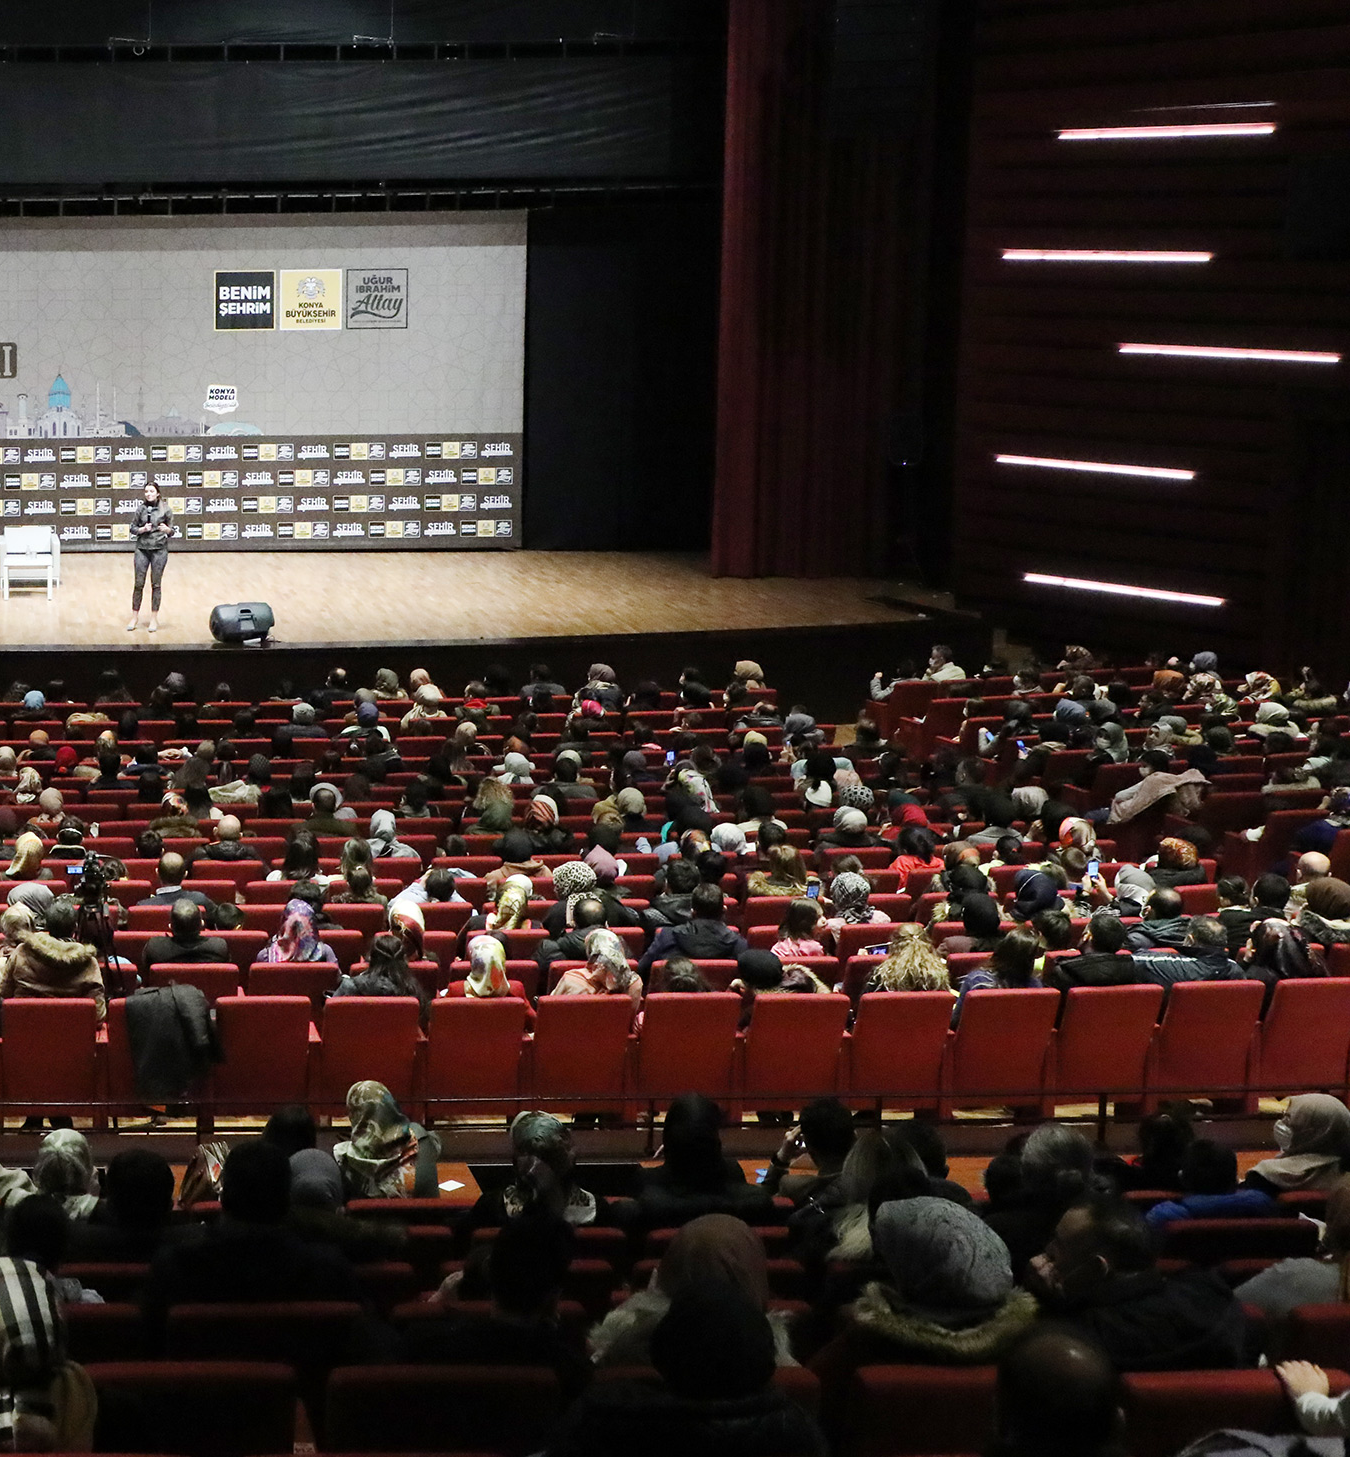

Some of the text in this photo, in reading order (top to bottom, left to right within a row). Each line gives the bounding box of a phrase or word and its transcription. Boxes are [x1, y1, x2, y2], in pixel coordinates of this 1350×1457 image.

[362, 275, 393, 285] UĞUR
[219, 286, 271, 300] BENİM
[219, 302, 271, 317] ŞEHRİM
[350, 293, 405, 319] Altay
